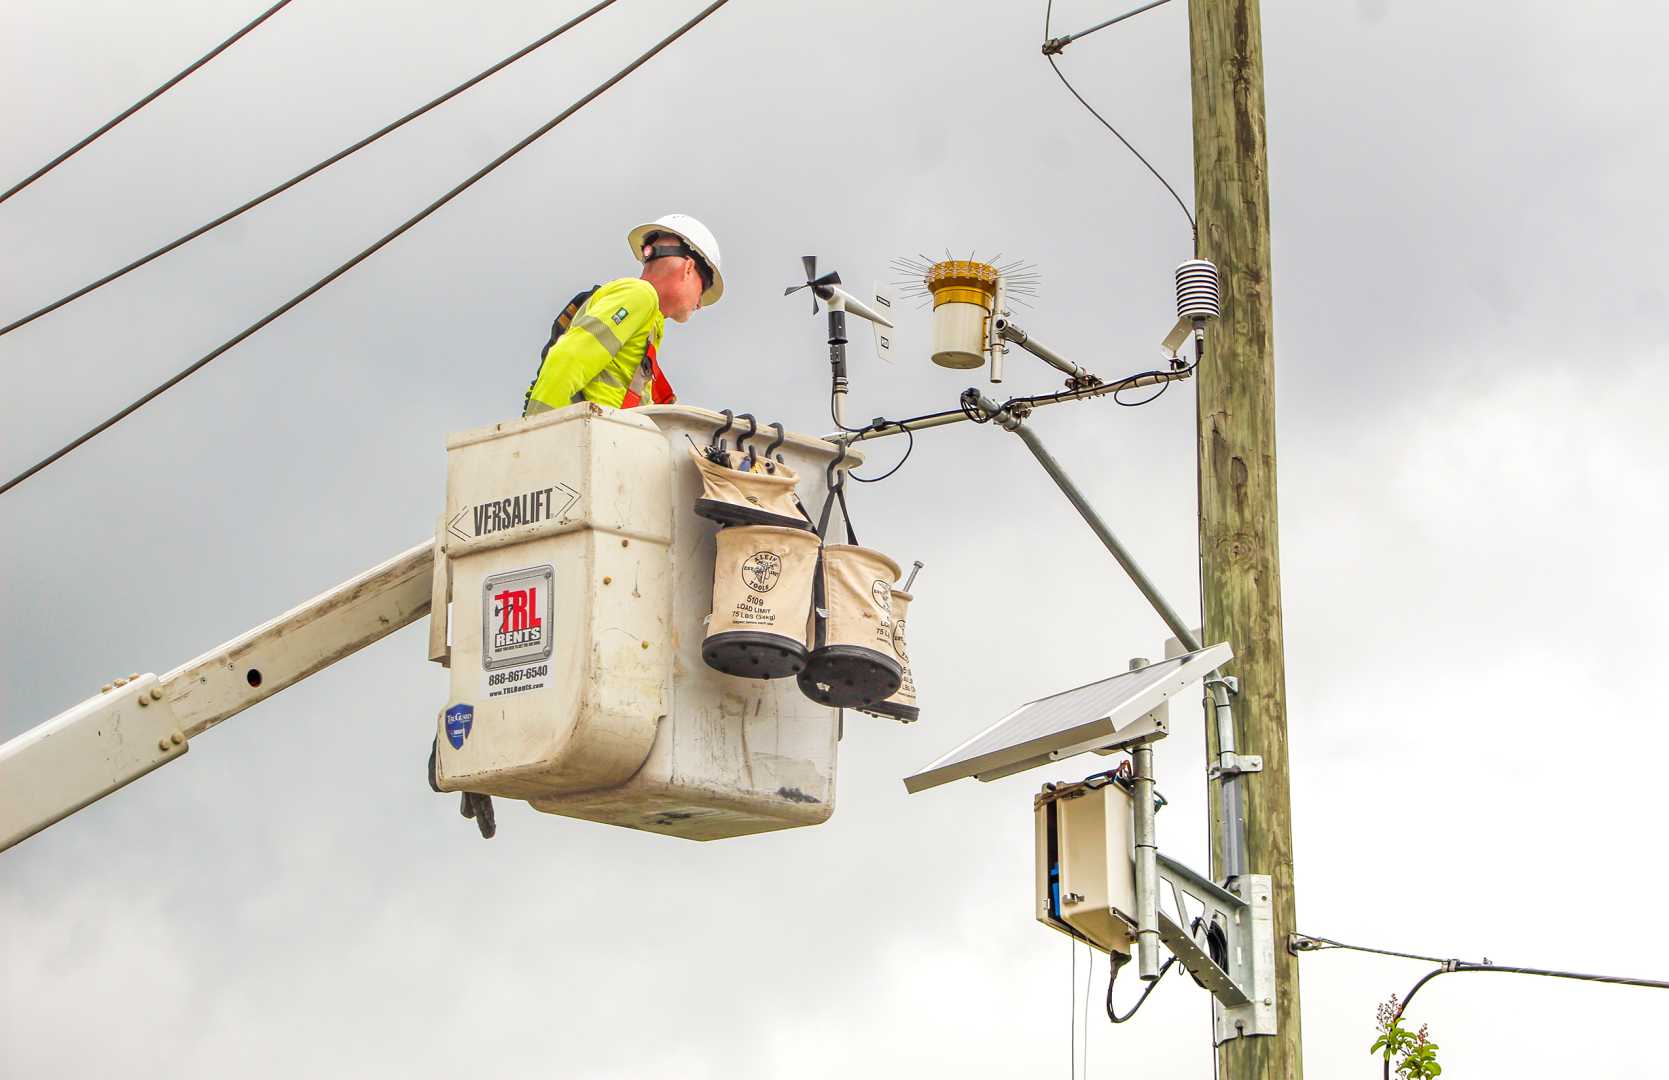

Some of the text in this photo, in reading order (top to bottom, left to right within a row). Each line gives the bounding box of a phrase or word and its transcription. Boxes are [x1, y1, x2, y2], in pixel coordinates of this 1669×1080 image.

[473, 488, 553, 537] VERSALIFT
[754, 554, 777, 563] KLEIN
[749, 580, 769, 591] TOOLS
[746, 595, 764, 606] 5109
[495, 587, 542, 633] TRL
[737, 603, 753, 612] LOAD
[741, 612, 754, 620] LBS
[495, 626, 542, 647] RENTS
[488, 665, 548, 686] 888-867-6540
